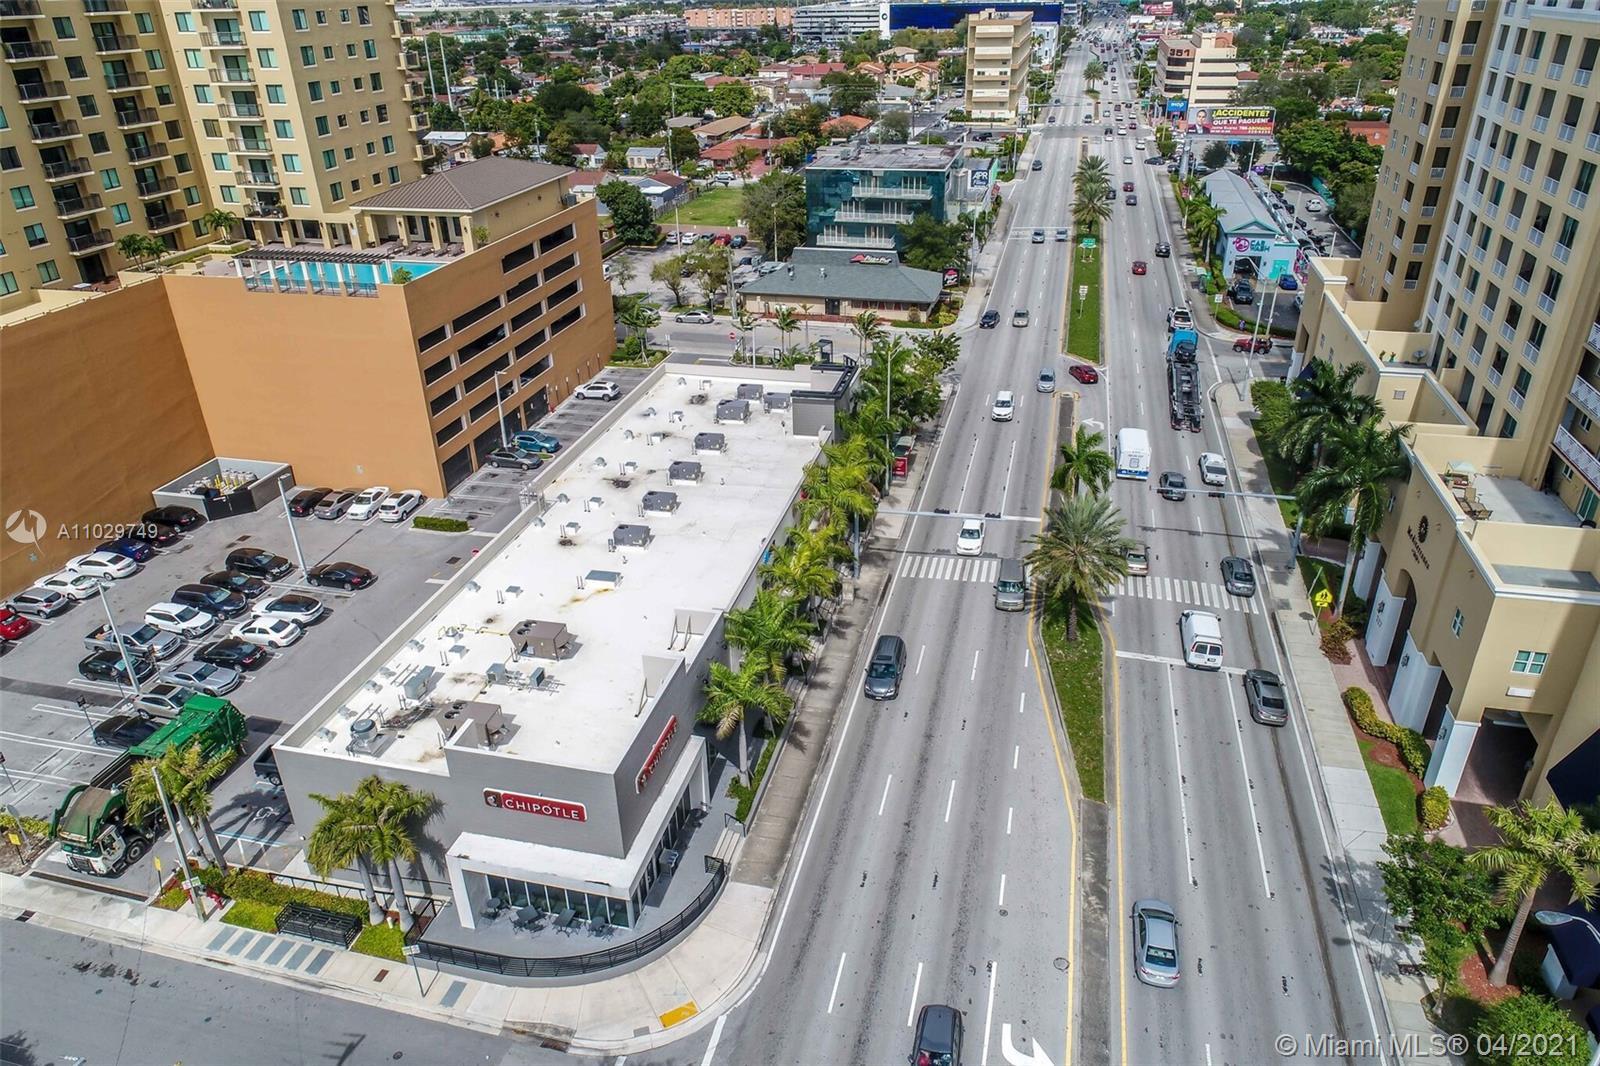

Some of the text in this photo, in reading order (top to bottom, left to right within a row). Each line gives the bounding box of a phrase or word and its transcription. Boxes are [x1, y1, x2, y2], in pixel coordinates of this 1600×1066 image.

[1169, 48, 1190, 57] 351
[1213, 118, 1229, 126] QUE
[972, 171, 988, 180] APR
[649, 721, 677, 775] CHIPOTLE
[504, 799, 580, 820] CHIPOTLE
